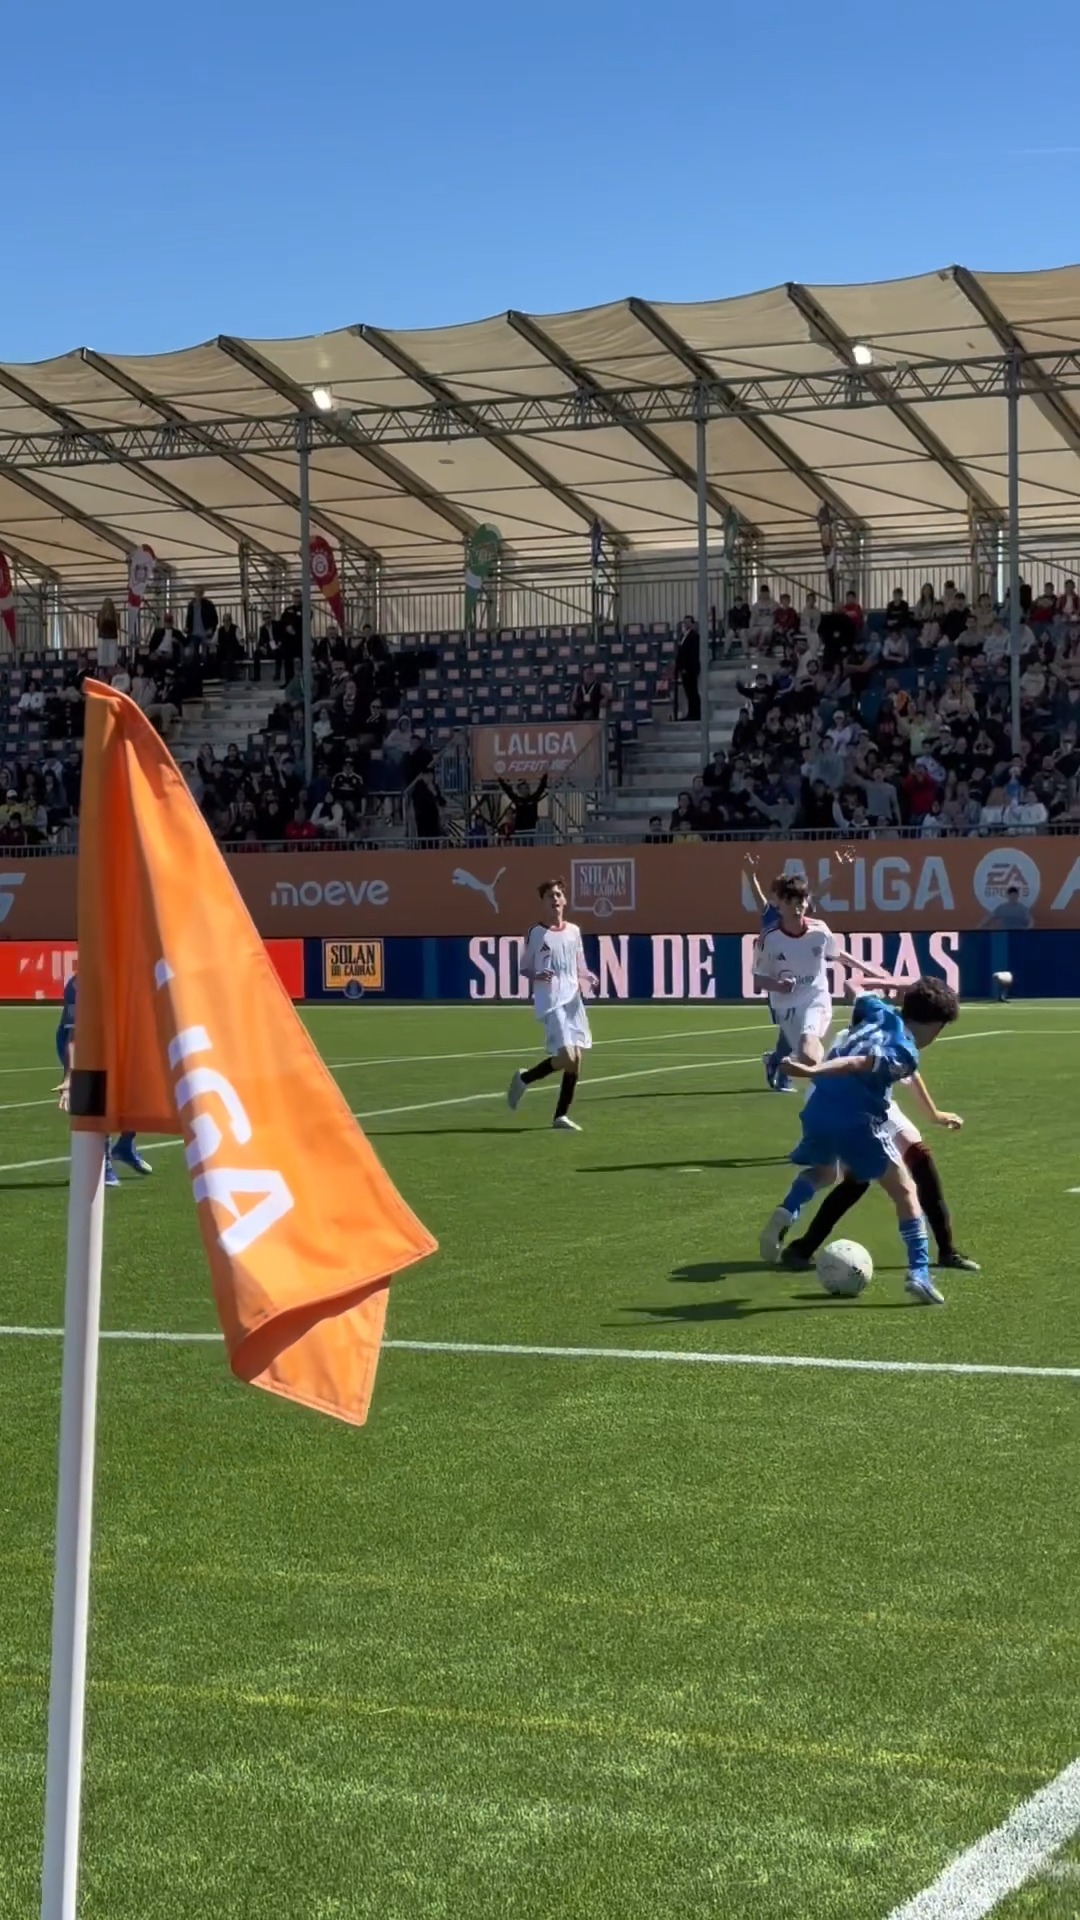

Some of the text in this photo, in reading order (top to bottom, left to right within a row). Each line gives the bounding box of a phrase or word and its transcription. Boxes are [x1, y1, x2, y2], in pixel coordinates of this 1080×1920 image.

[494, 731, 577, 756] LALIGA
[579, 865, 626, 886] SOLAN
[986, 862, 1029, 886] EA
[271, 879, 390, 907] moeve
[984, 886, 1030, 898] SPOTS
[330, 944, 376, 965] SOLAN
[469, 931, 960, 999] SON DE CRAS
